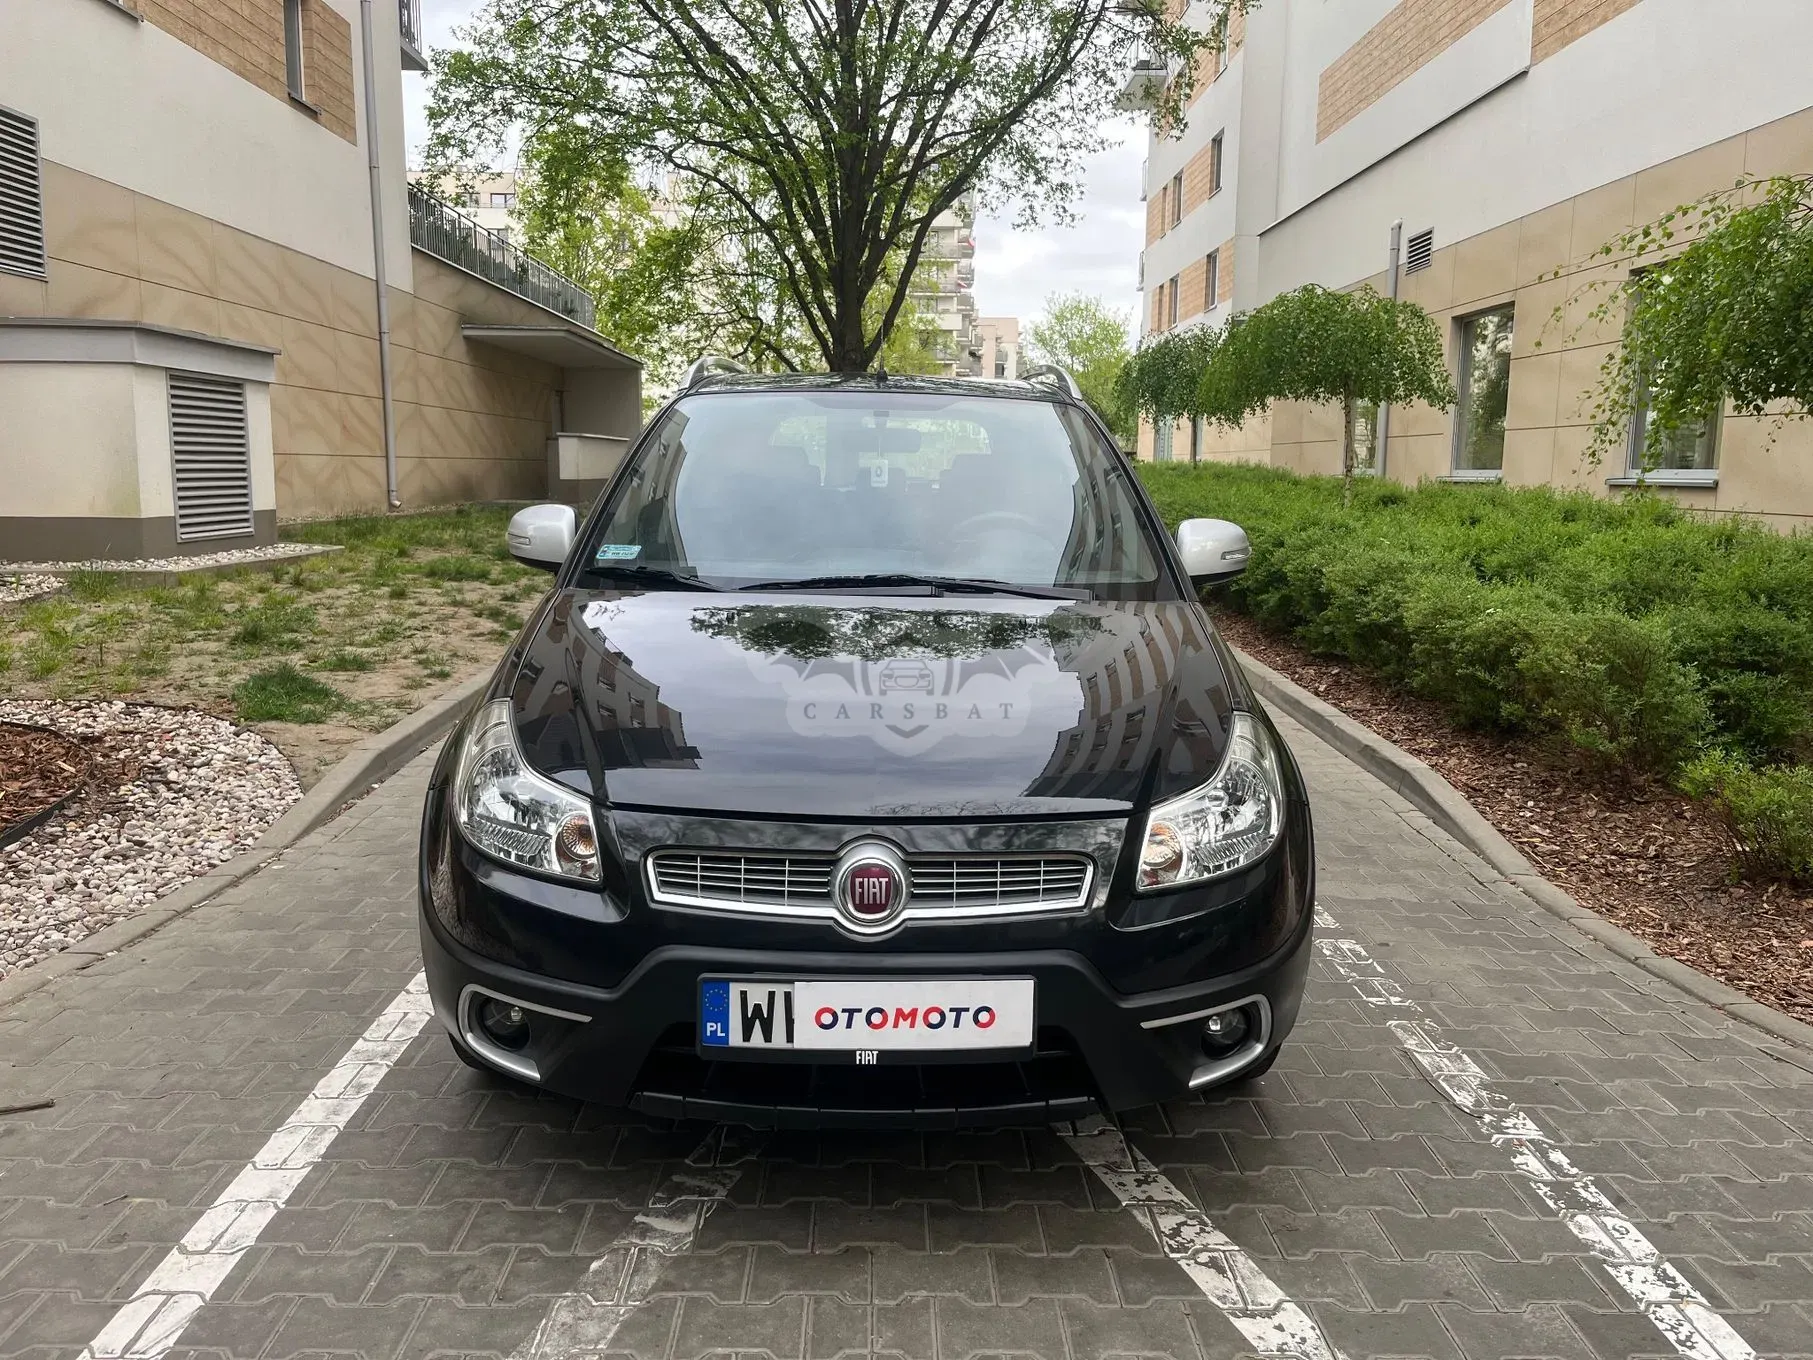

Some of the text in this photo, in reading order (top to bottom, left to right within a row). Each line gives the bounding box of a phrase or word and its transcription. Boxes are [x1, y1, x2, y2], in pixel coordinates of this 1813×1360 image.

[855, 878, 889, 904] FIAT
[815, 1006, 995, 1030] OTOMOTO
[706, 1022, 726, 1037] PL
[856, 1050, 879, 1065] FIAT
